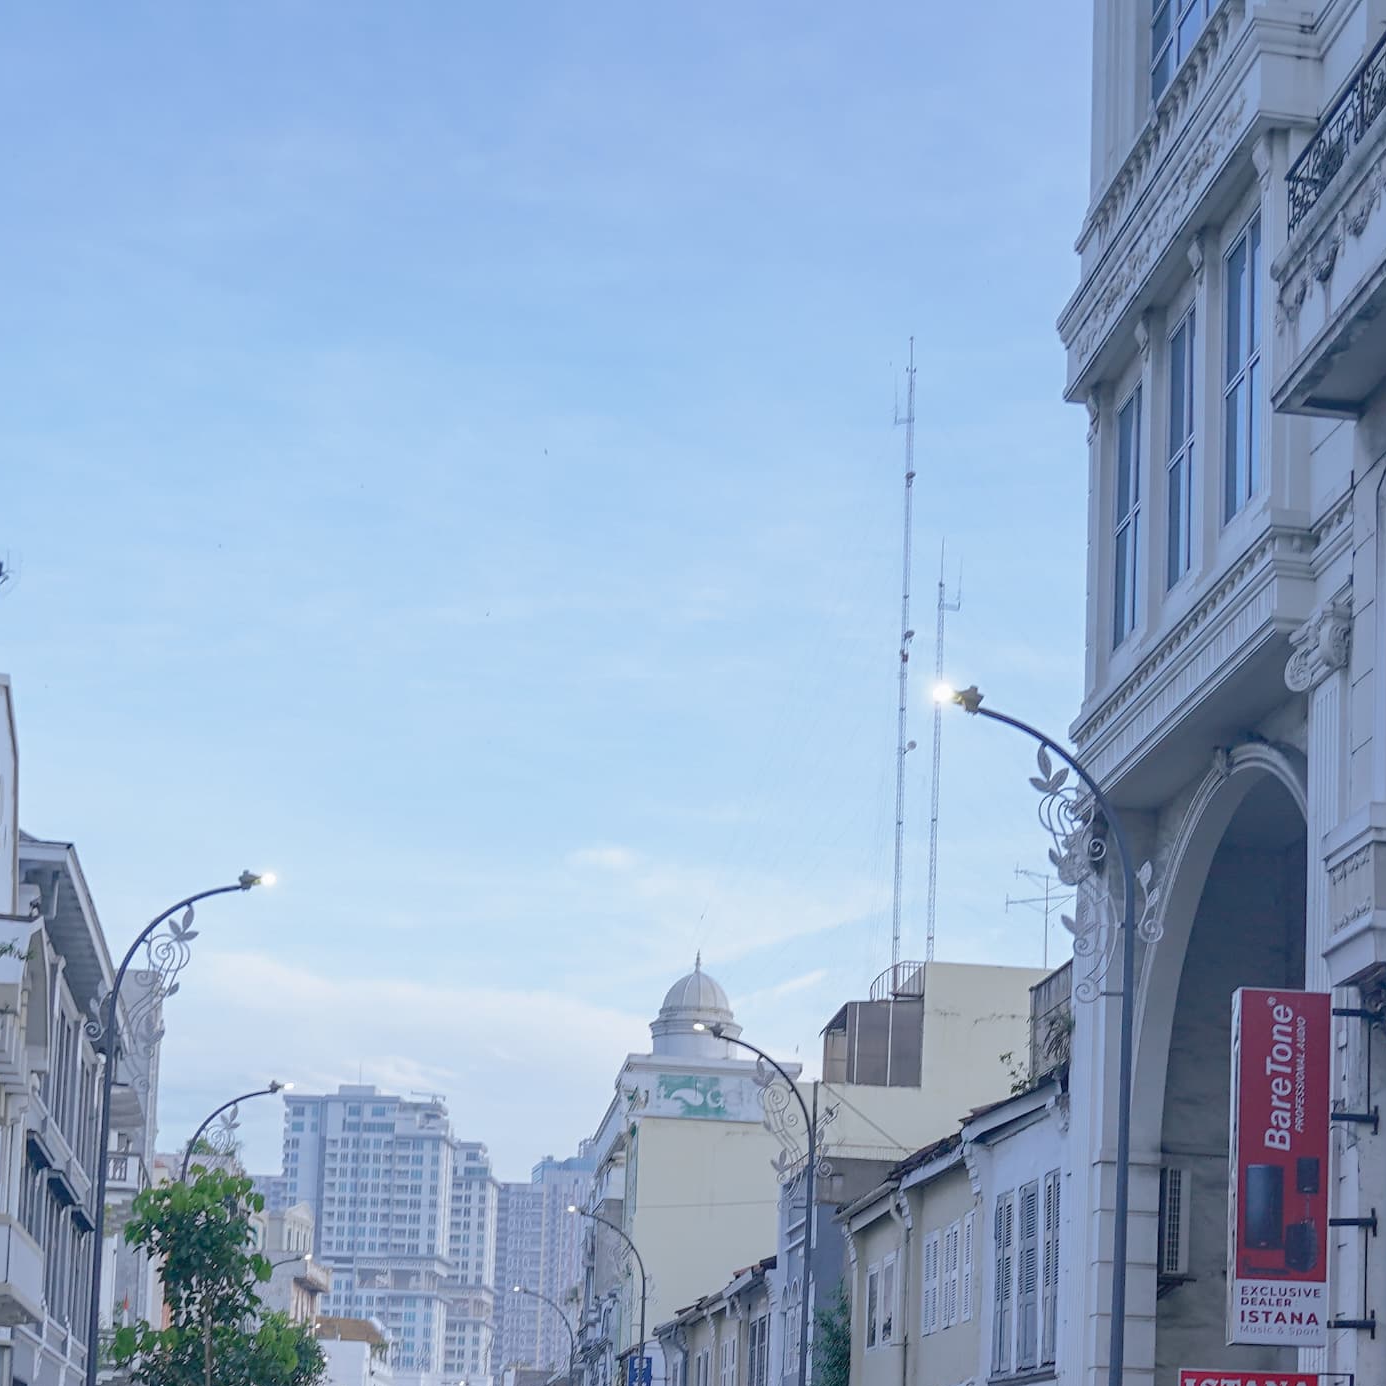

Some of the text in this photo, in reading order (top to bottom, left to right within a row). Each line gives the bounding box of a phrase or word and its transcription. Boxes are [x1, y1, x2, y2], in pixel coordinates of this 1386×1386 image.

[1241, 1286, 1321, 1298] EXCLUSIVE
[1240, 1310, 1319, 1326] ISTANA
[1240, 1325, 1273, 1334] Music
[1288, 1327, 1319, 1337] Sport
